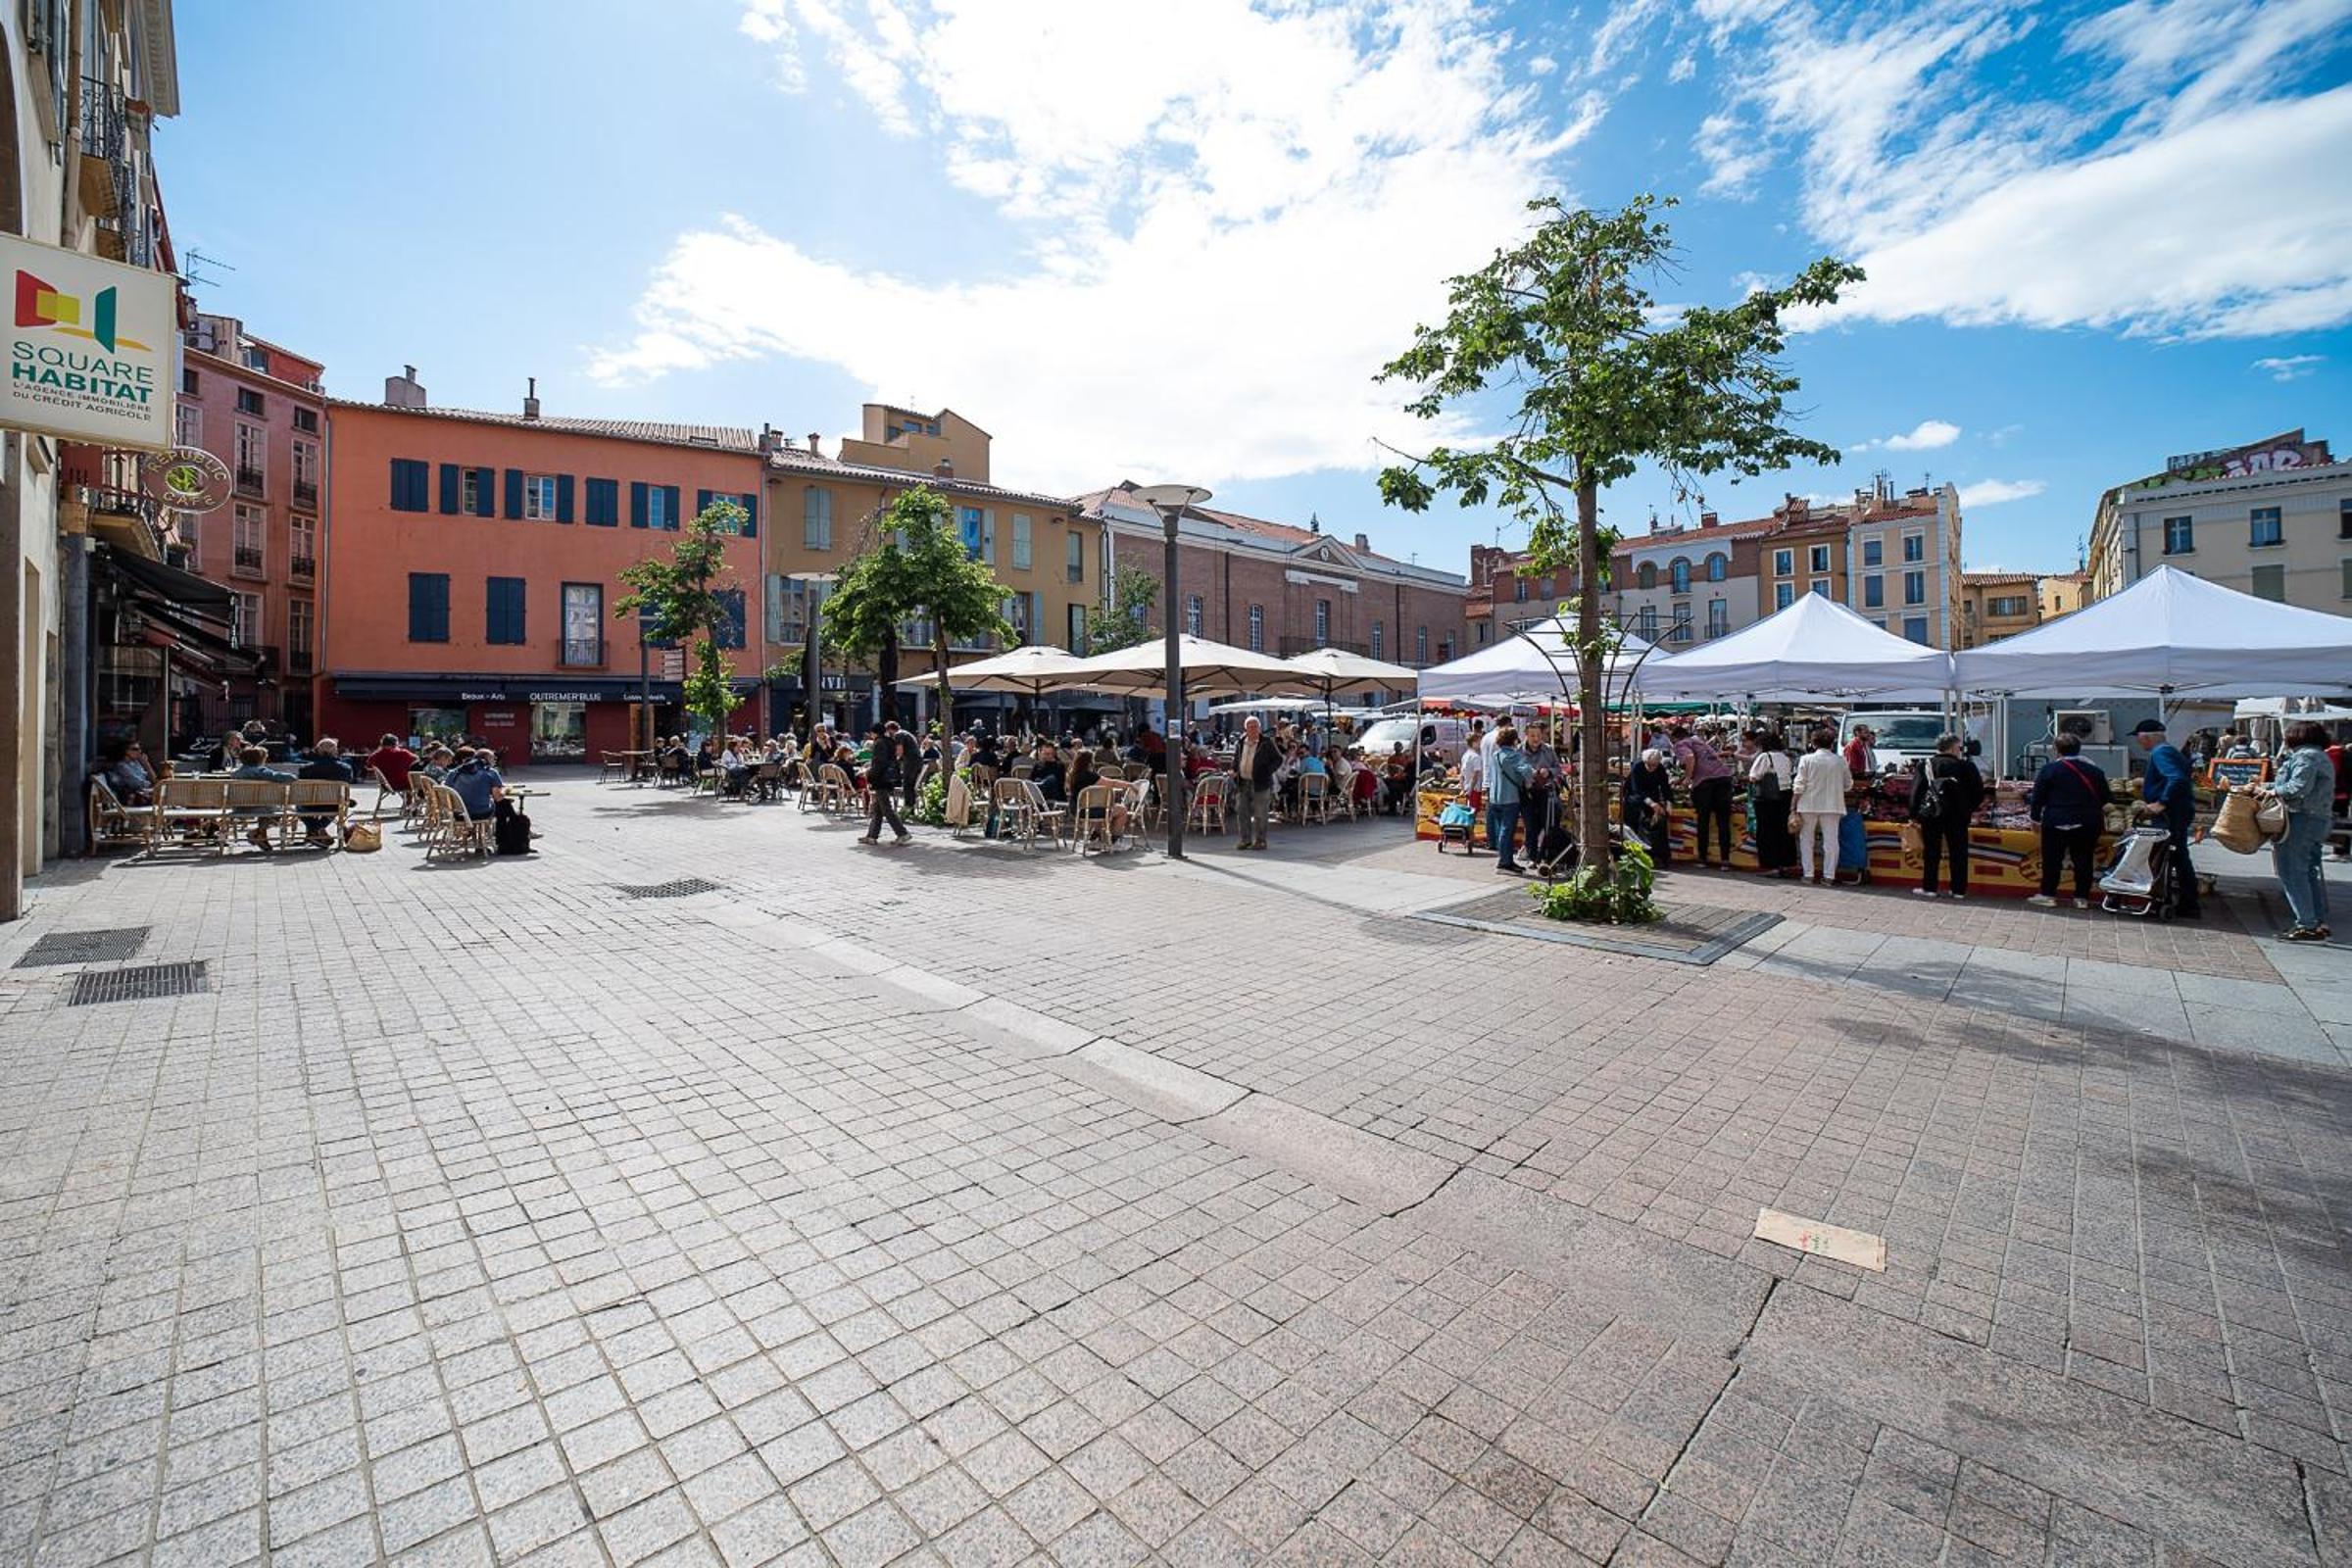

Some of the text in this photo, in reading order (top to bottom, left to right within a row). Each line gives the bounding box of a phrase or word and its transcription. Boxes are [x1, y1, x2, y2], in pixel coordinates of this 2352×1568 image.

[12, 341, 154, 385] SQUARE
[12, 362, 154, 404] HABITAT
[14, 381, 75, 399] L'AGENCE
[85, 404, 151, 421] AGRICOLE
